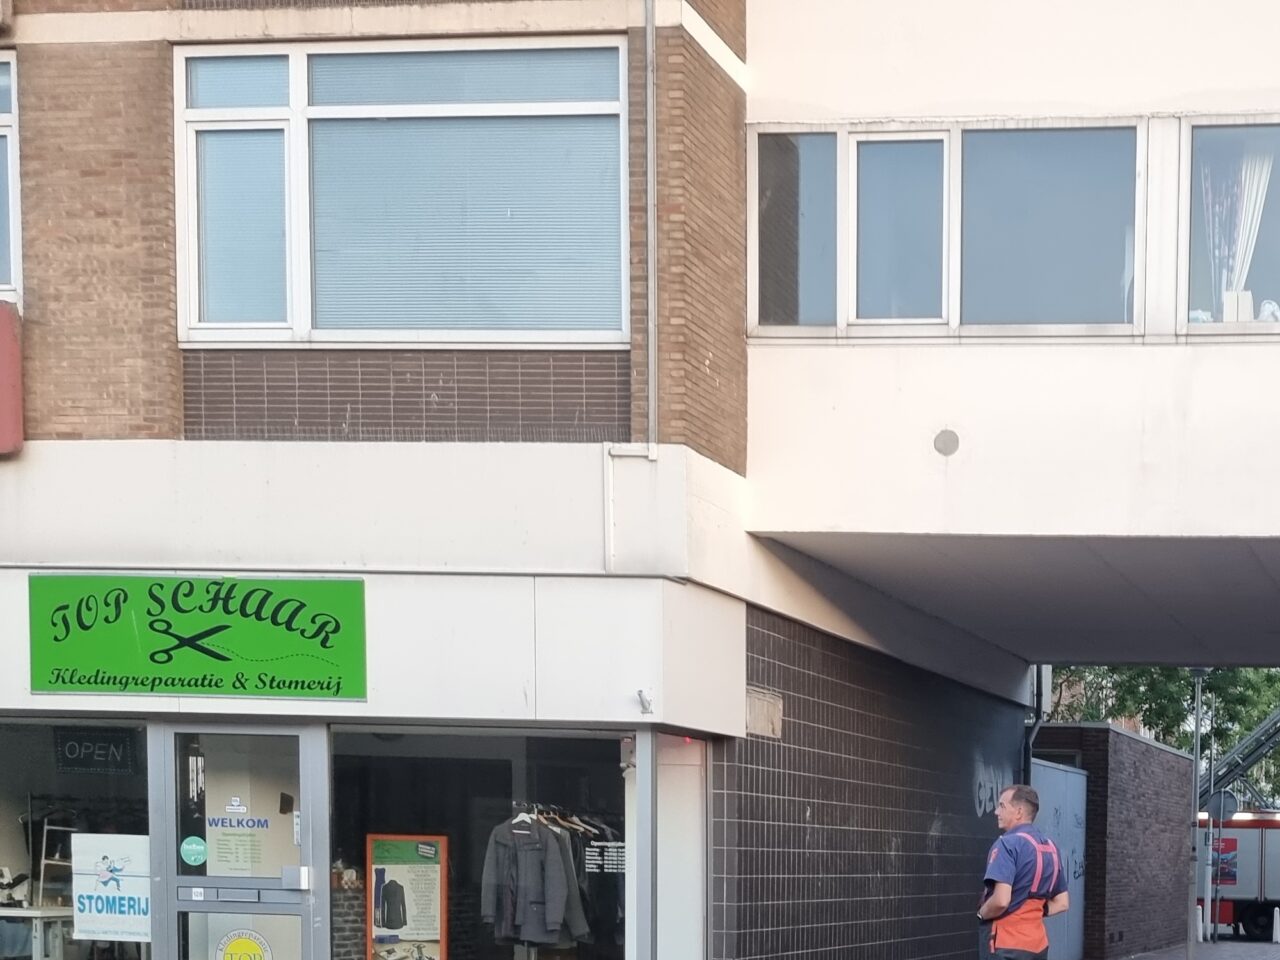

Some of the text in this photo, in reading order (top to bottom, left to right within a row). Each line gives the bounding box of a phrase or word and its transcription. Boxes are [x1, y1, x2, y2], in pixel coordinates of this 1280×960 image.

[51, 580, 341, 649] TOP SCHAAR
[49, 668, 343, 697] Kledingreparatie & Stomerij
[65, 741, 123, 761] OPEN
[207, 817, 269, 829] WELKOM
[77, 894, 149, 916] STOMERIJ
